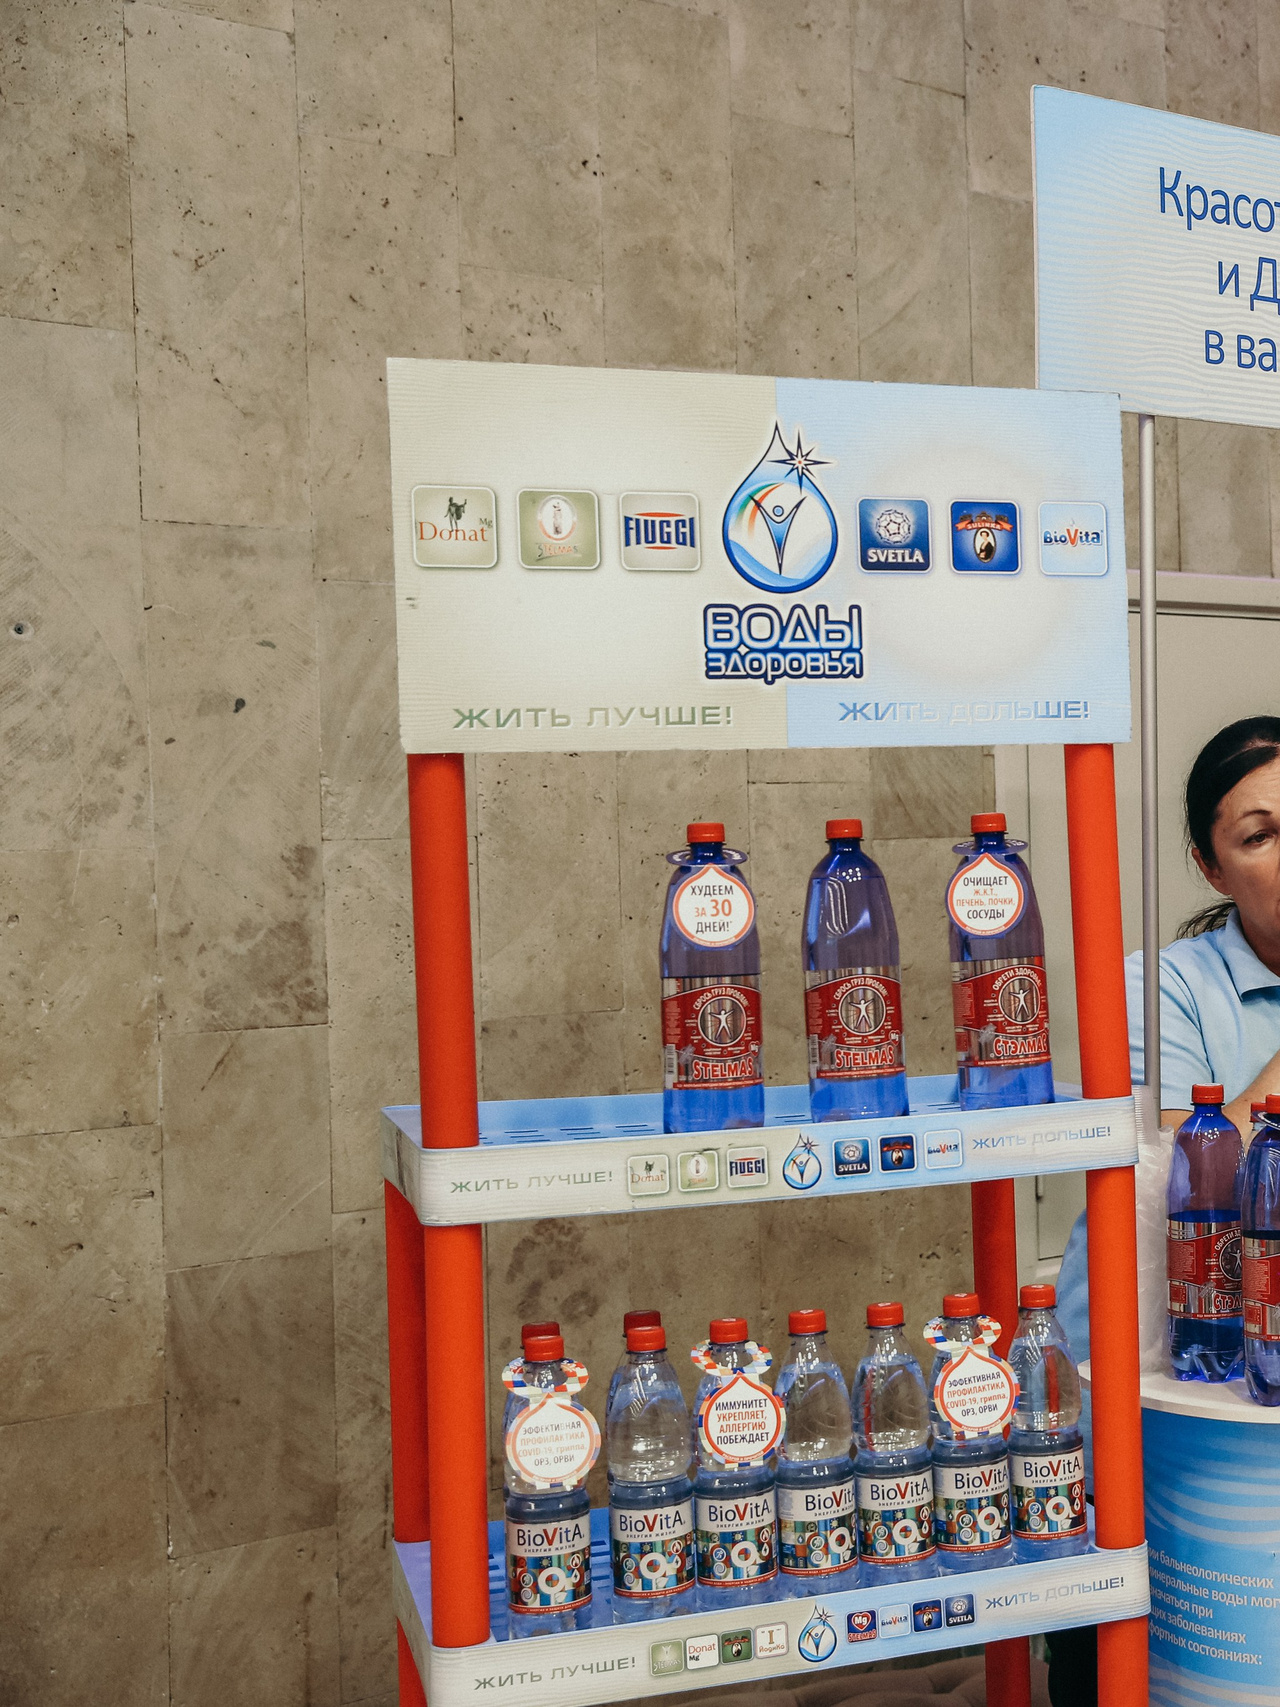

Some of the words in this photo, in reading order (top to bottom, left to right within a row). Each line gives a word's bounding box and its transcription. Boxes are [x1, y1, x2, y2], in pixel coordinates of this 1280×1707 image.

[1218, 260, 1239, 297] и
[1205, 330, 1224, 364] в
[419, 521, 488, 542] Donat
[479, 517, 493, 528] Mg
[624, 515, 694, 548] FIUGGI
[1043, 527, 1101, 547] BioVita
[868, 549, 924, 563] SVETLA
[706, 606, 862, 649] ВОДЫ
[452, 708, 571, 729] ЖИТЬ
[587, 707, 732, 727] ЛУЧШЕ!
[839, 702, 939, 722] ЖИТЬ
[949, 701, 1090, 725] ДОЛЬШЕ!
[963, 876, 1008, 887] ОЧИЩАЕТ
[691, 885, 733, 897] ХУДЕЕМ
[695, 907, 706, 917] ЗА
[710, 899, 732, 917] 30
[967, 909, 1004, 920] СОСУДЫ
[835, 1045, 894, 1068] STELMAS
[693, 1057, 753, 1079] STELMAS
[972, 1133, 1026, 1150] ЖИТЬ
[1032, 1126, 1111, 1145] ДОЛЬШЕ!
[730, 1158, 765, 1176] FIUGGI
[839, 1163, 867, 1172] SVETLA
[451, 1179, 519, 1194] ЖИТЬ
[527, 1172, 613, 1188] ЛУЧШЕ!
[631, 1173, 664, 1184] Donat
[1213, 1294, 1242, 1310] СТЭЛ
[948, 1372, 1000, 1388] ЭФФЕКТИВНАЯ
[947, 1382, 1005, 1398] ПРОФИЛАКТИКА
[715, 1399, 767, 1411] ИММУНИТЕТ
[946, 1398, 978, 1409] COVID-19,
[962, 1408, 977, 1417] ОРЗ,
[979, 1404, 997, 1413] ОРВИ
[717, 1410, 767, 1422] УКРЕПЛЯЕТ,
[523, 1421, 581, 1435] ЭФФЕКТИВНАЯ
[720, 1421, 766, 1433] АЛЛЕРГИЮ
[521, 1432, 584, 1446] ПРОФИЛАКТИКА
[717, 1432, 769, 1445] ПОБЕЖДАЕТ
[534, 1458, 551, 1466] ОРЗ,
[554, 1455, 574, 1463] ОРВИ
[1024, 1456, 1080, 1478] BioVitA
[870, 1478, 929, 1500] BioVitA
[709, 1499, 770, 1521] BioVitA
[620, 1511, 683, 1532] BioVitA
[517, 1524, 582, 1546] BioVitA
[1160, 1550, 1274, 1588] бальнеологических
[986, 1591, 1040, 1609] ЖИТЬ
[1045, 1577, 1124, 1602] ДОЛЬШЕ!
[1212, 1591, 1247, 1606] воды
[1192, 1603, 1213, 1618] при
[855, 1616, 867, 1625] Mg
[1168, 1614, 1246, 1644] заболеваниях
[688, 1643, 716, 1654] Donat
[1188, 1640, 1262, 1665] состояниях:
[475, 1672, 542, 1689] ЖИТЬ
[551, 1657, 635, 1680] ЛУЧШЕ!
